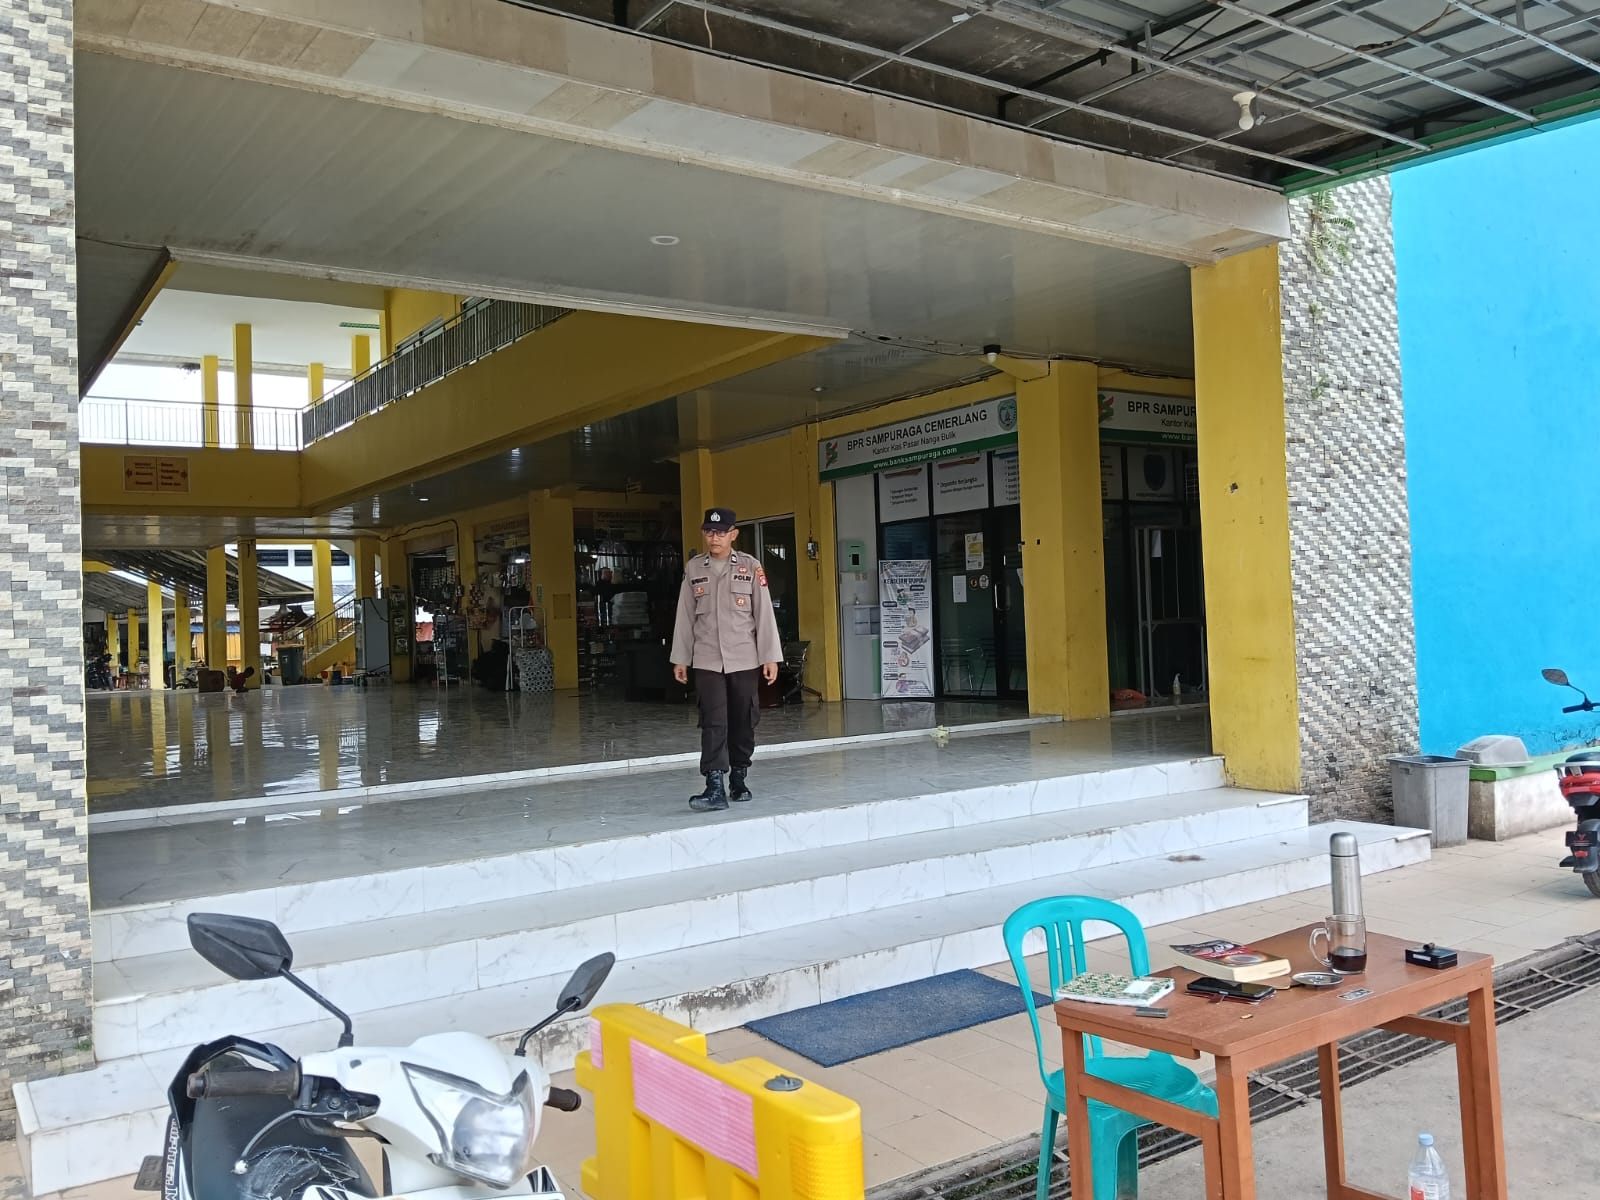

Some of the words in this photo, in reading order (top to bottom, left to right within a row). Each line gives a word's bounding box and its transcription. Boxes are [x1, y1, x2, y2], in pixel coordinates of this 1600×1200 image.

[1127, 400, 1150, 414] BPR
[847, 437, 865, 451] BPR
[866, 424, 923, 447] SAMPURAGA
[924, 410, 987, 432] CEMERLANG
[1161, 418, 1183, 428] Kantor
[872, 445, 891, 456] Kantor
[890, 443, 902, 453] Kas
[902, 439, 920, 449] Pasar
[920, 436, 941, 447] Nanga
[941, 431, 956, 442] Bulik
[873, 447, 957, 469] www.banksampuraga.com
